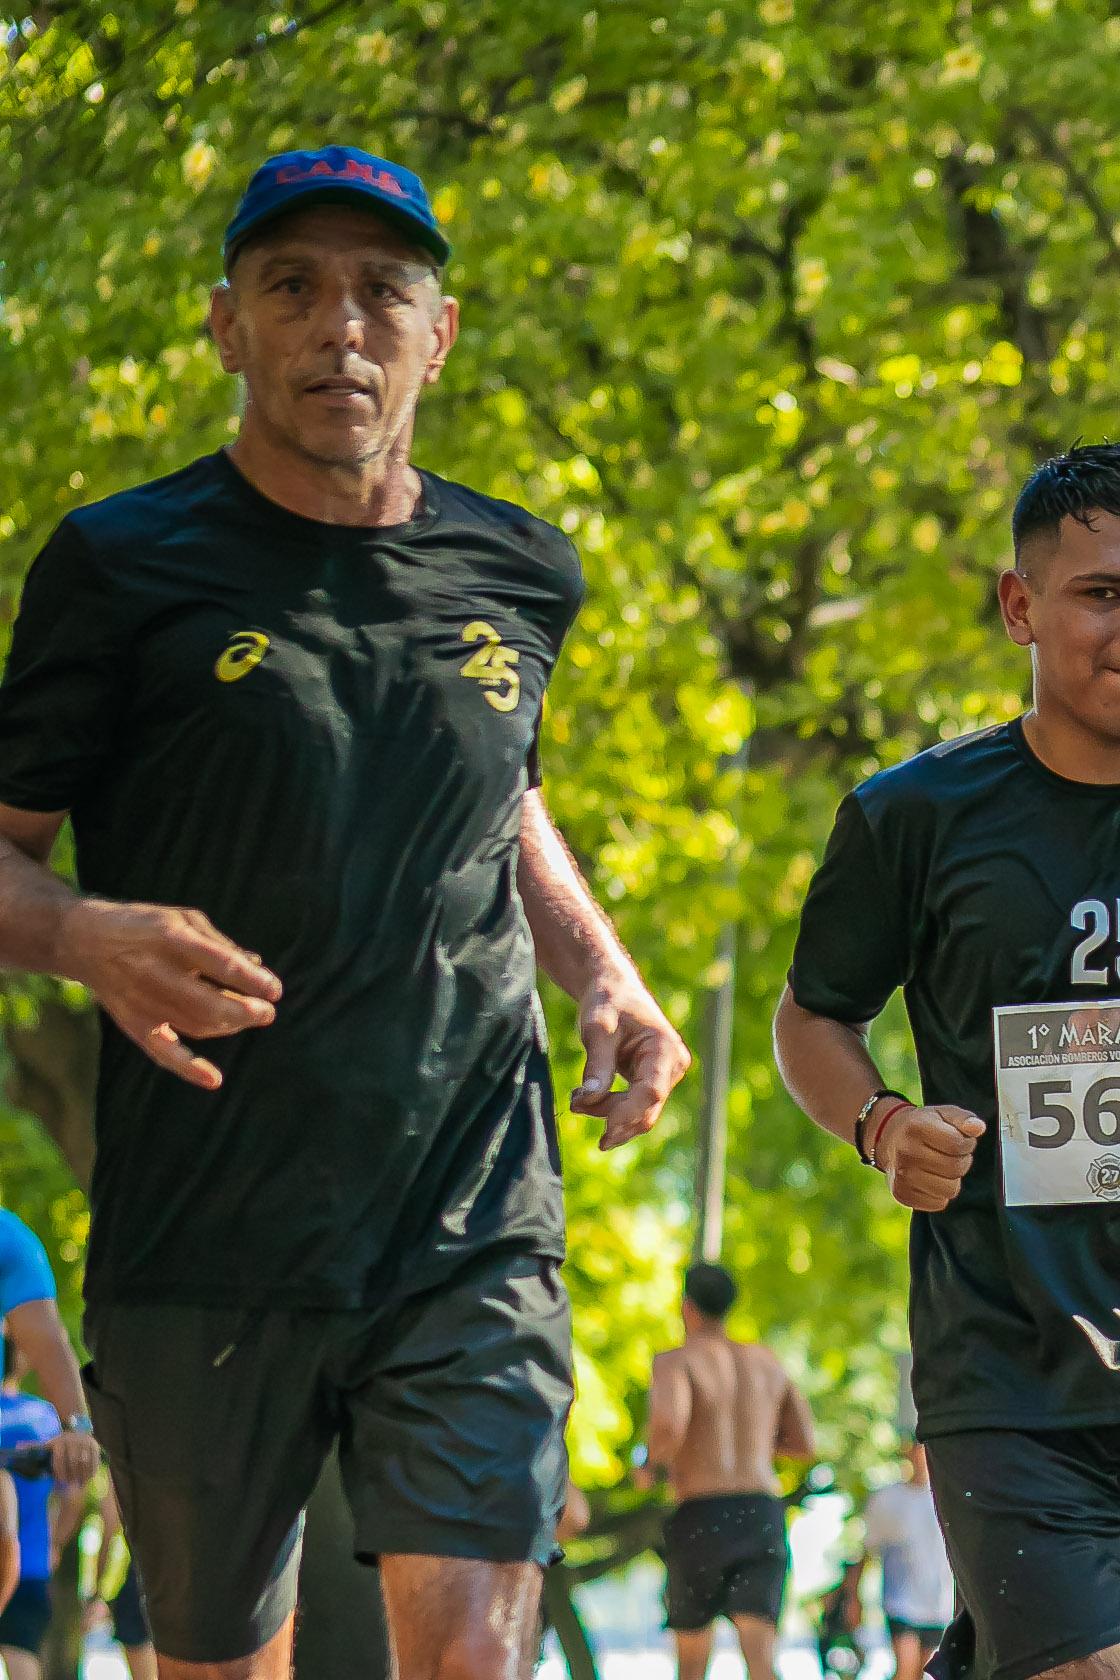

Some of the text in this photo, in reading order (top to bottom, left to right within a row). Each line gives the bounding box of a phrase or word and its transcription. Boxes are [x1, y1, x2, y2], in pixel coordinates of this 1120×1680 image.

[460, 620, 520, 712] 25
[1061, 1050, 1109, 1064] BOMBEROS
[1101, 1169, 1120, 1184] 27
